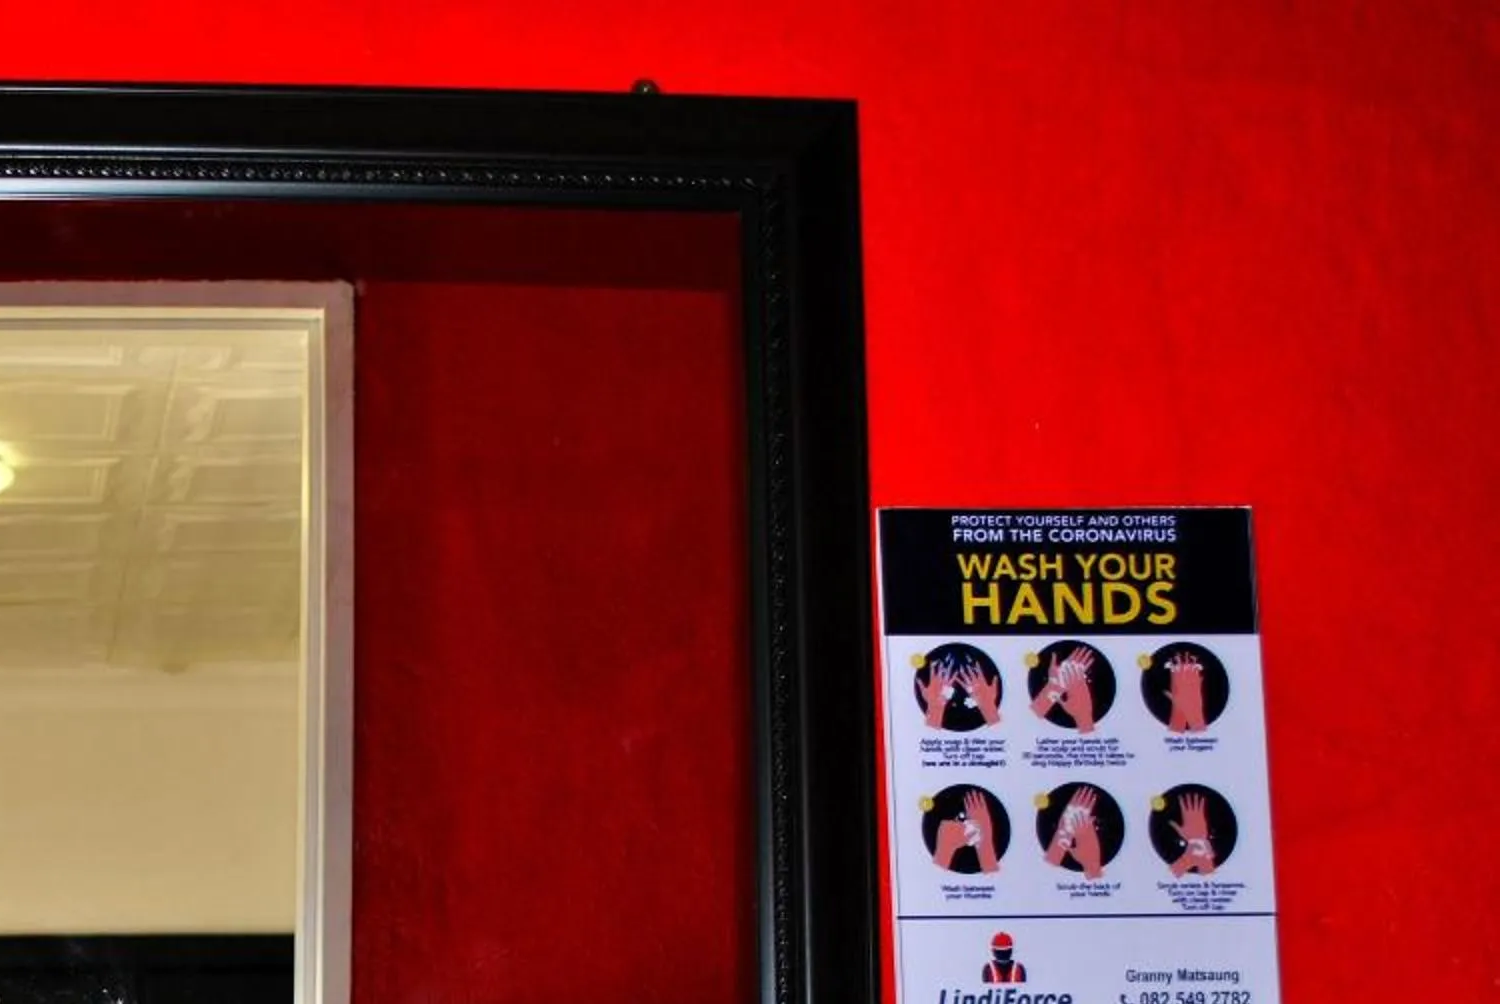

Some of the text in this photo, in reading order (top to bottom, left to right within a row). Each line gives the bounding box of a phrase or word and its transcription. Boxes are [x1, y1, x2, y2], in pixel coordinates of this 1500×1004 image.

[951, 515, 1176, 527] PROTECT YOURSELF AND OTHERS
[953, 528, 1177, 543] FROM THE CORONAVIRUS
[957, 553, 1177, 581] WASH YOUR
[961, 581, 1177, 625] HANDS
[1126, 967, 1240, 985] Granny Matsaung
